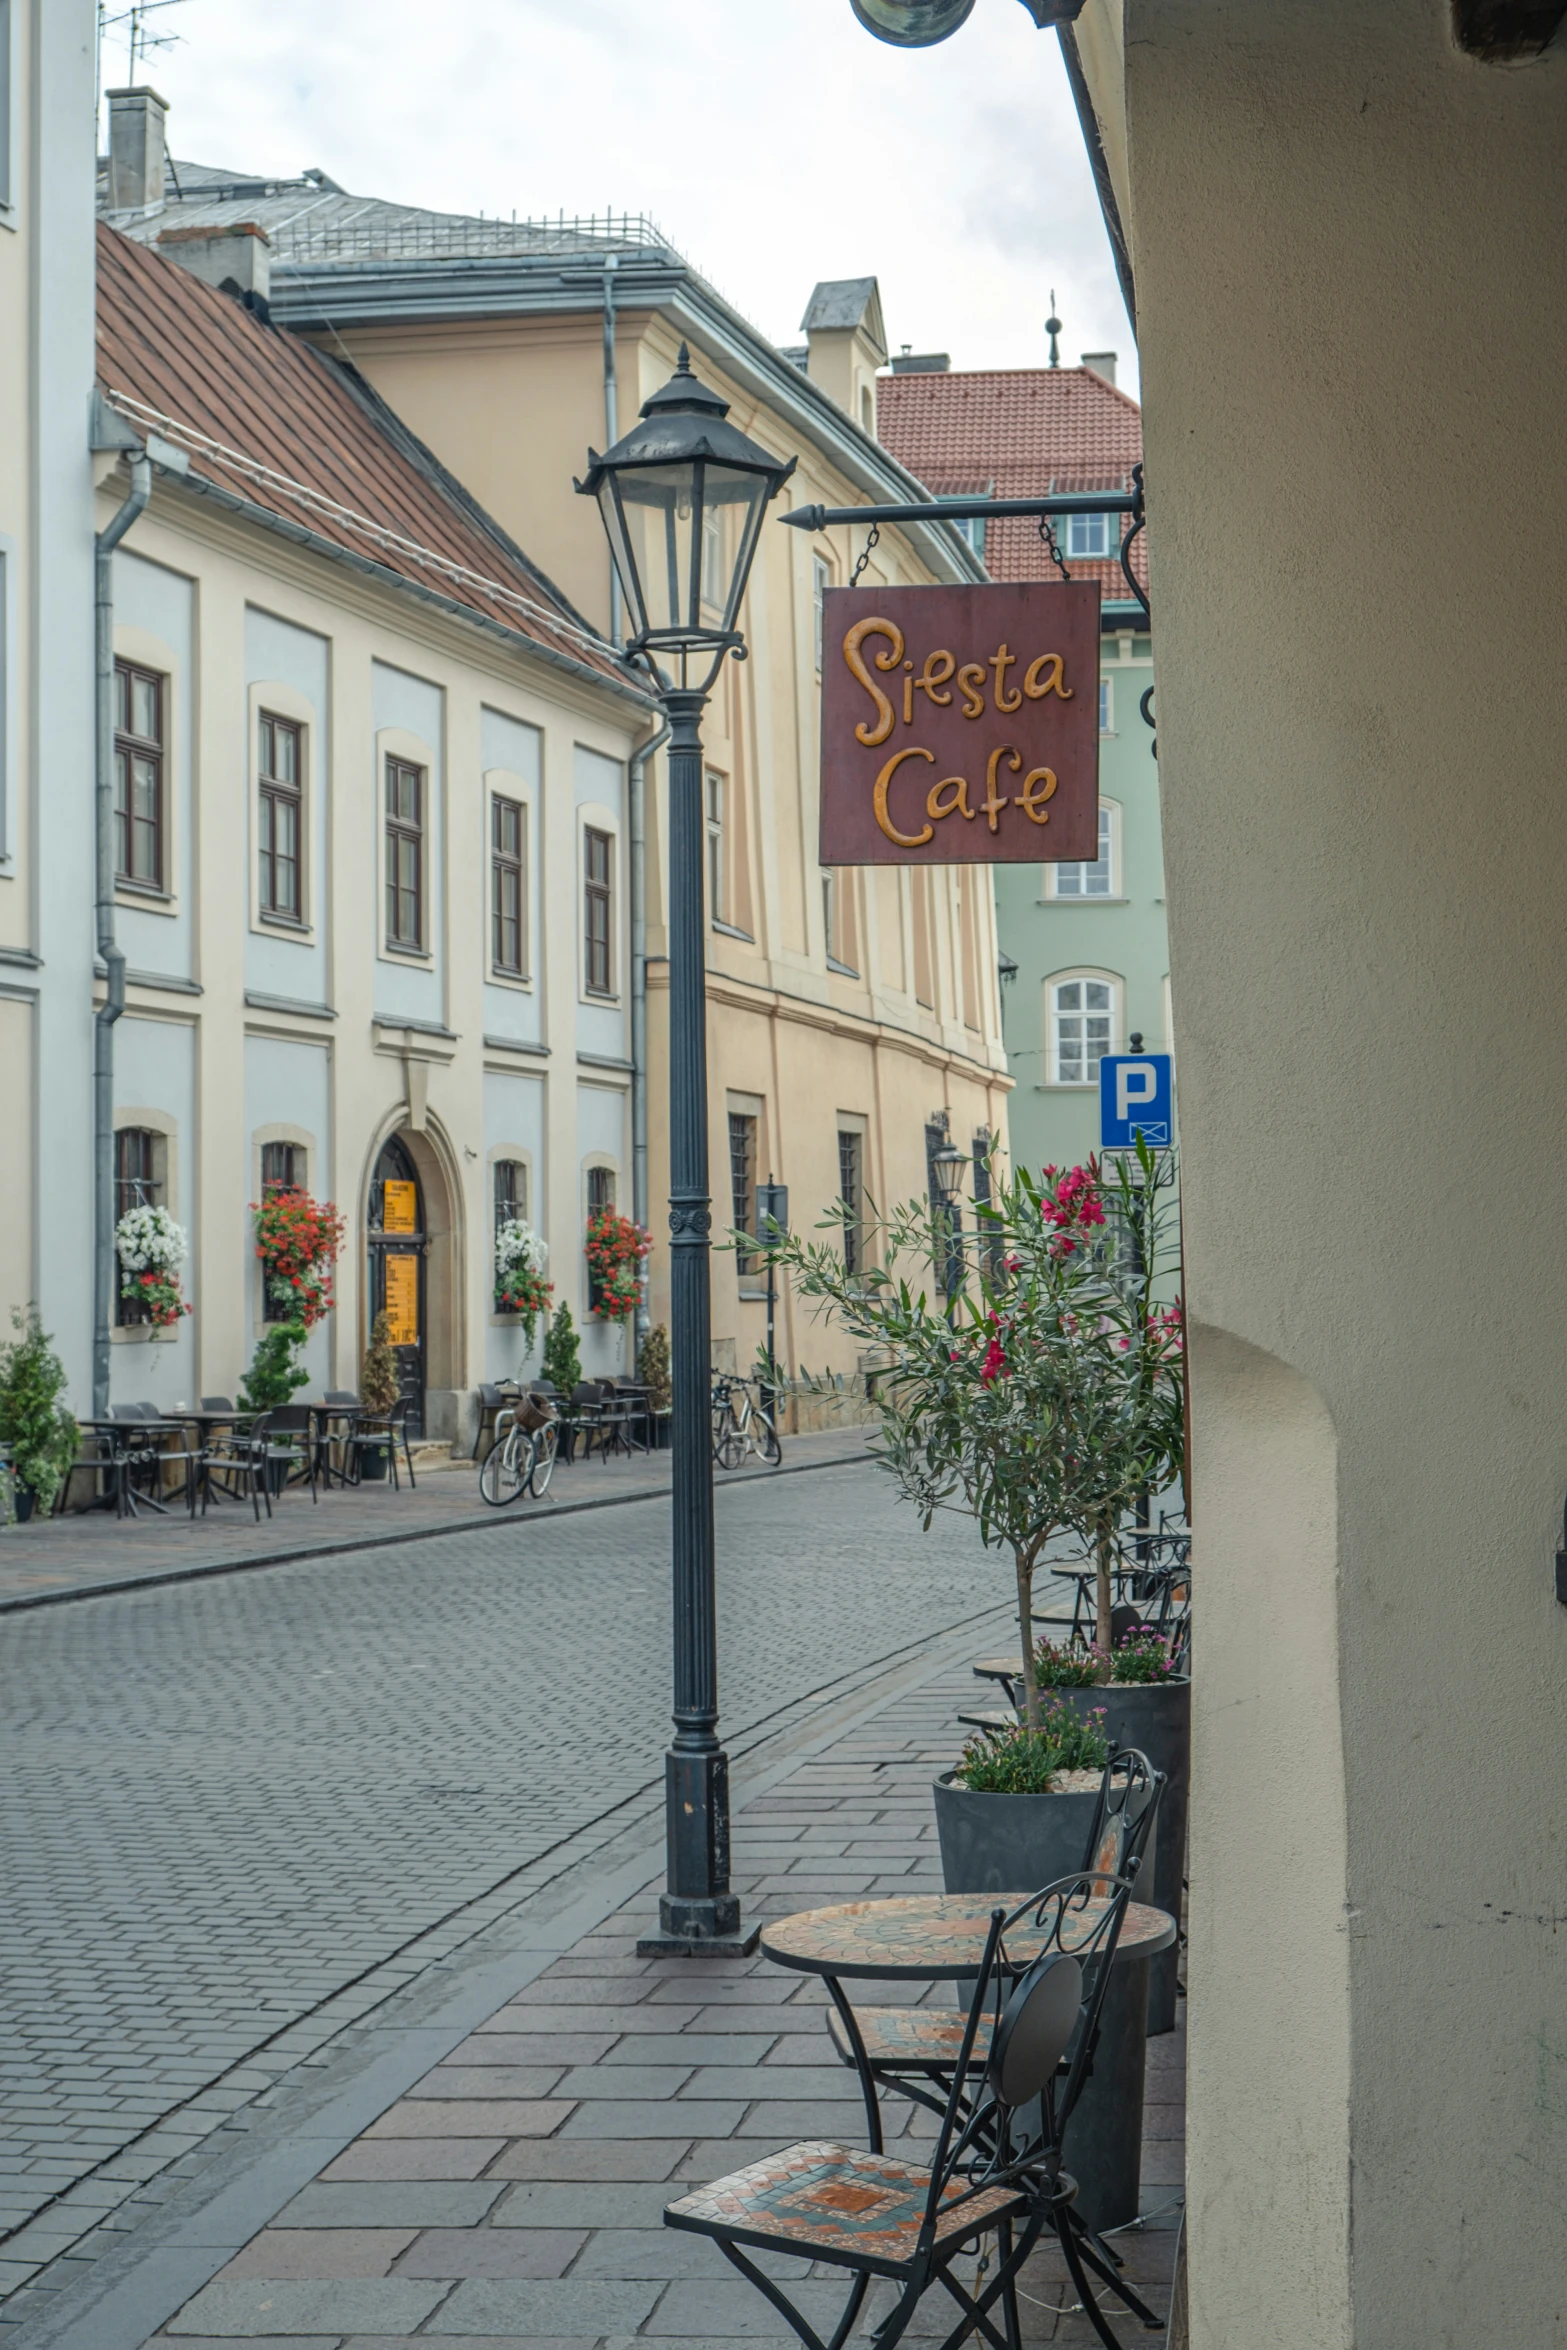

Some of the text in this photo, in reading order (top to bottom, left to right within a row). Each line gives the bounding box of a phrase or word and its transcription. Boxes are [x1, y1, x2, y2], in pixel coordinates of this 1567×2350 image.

[843, 617, 1073, 746] Siesta
[873, 744, 1058, 847] Cafe
[1116, 1062, 1157, 1120] P
